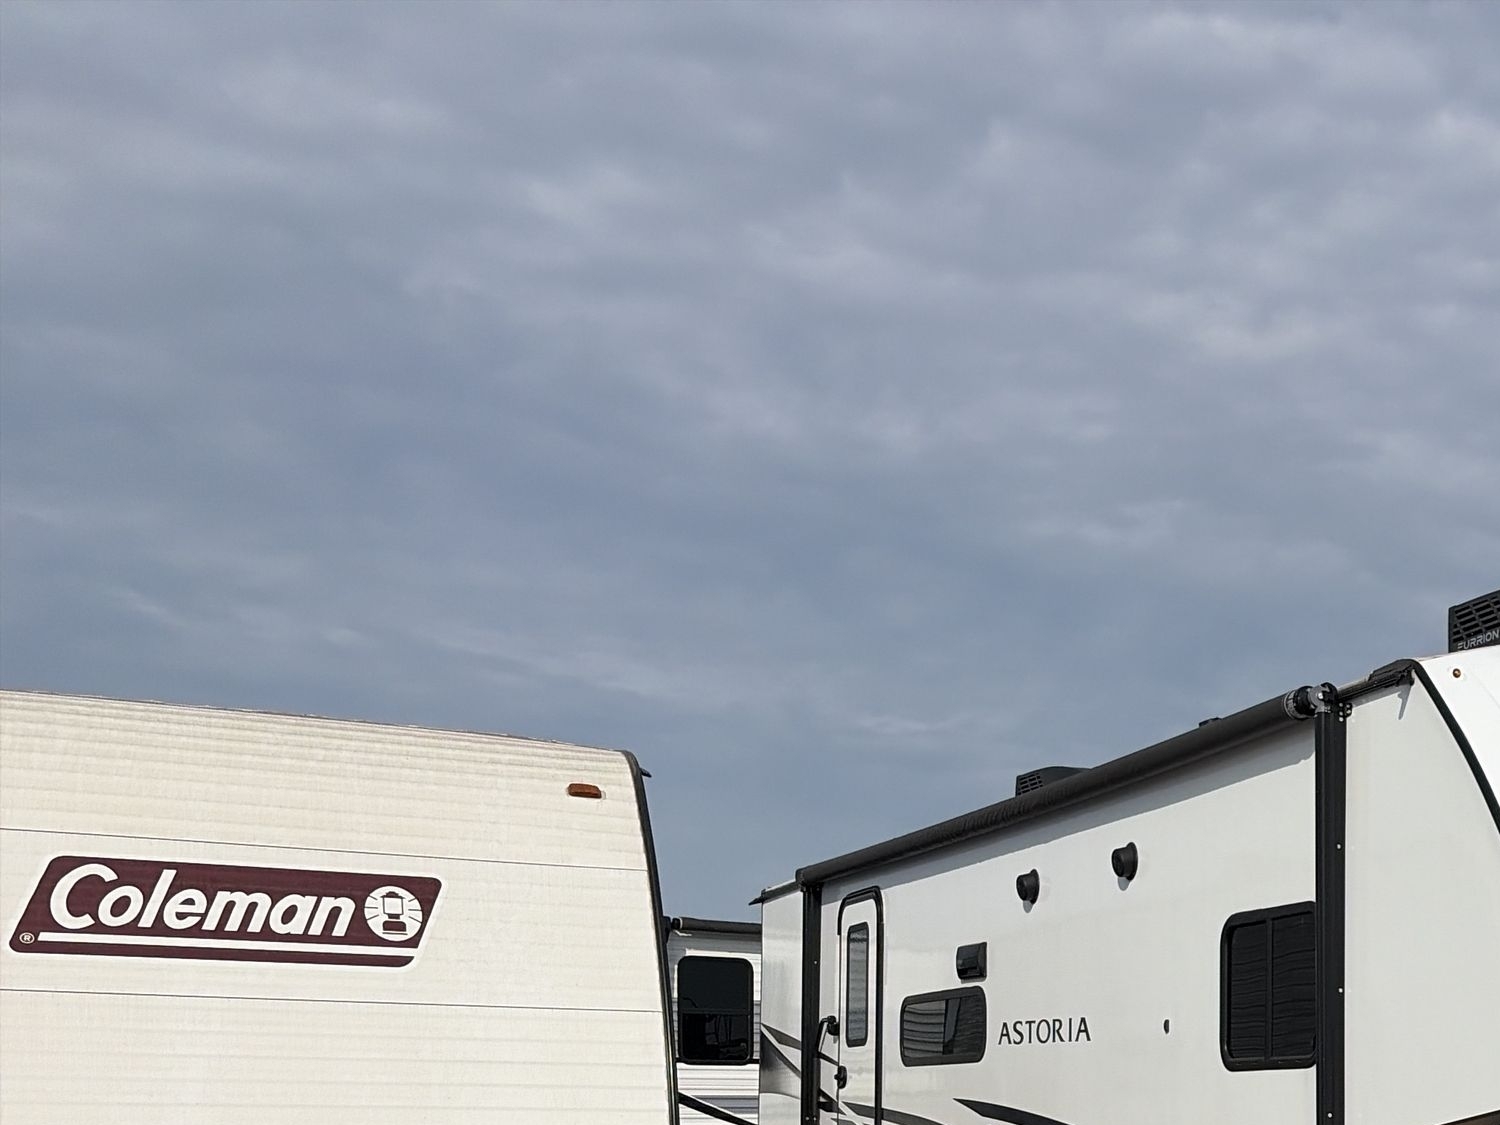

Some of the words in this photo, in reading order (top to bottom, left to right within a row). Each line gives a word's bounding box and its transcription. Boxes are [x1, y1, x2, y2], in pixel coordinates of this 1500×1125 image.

[1457, 628, 1500, 650] FURRION
[49, 863, 356, 938] Coleman
[998, 1017, 1092, 1045] ASTORIA
